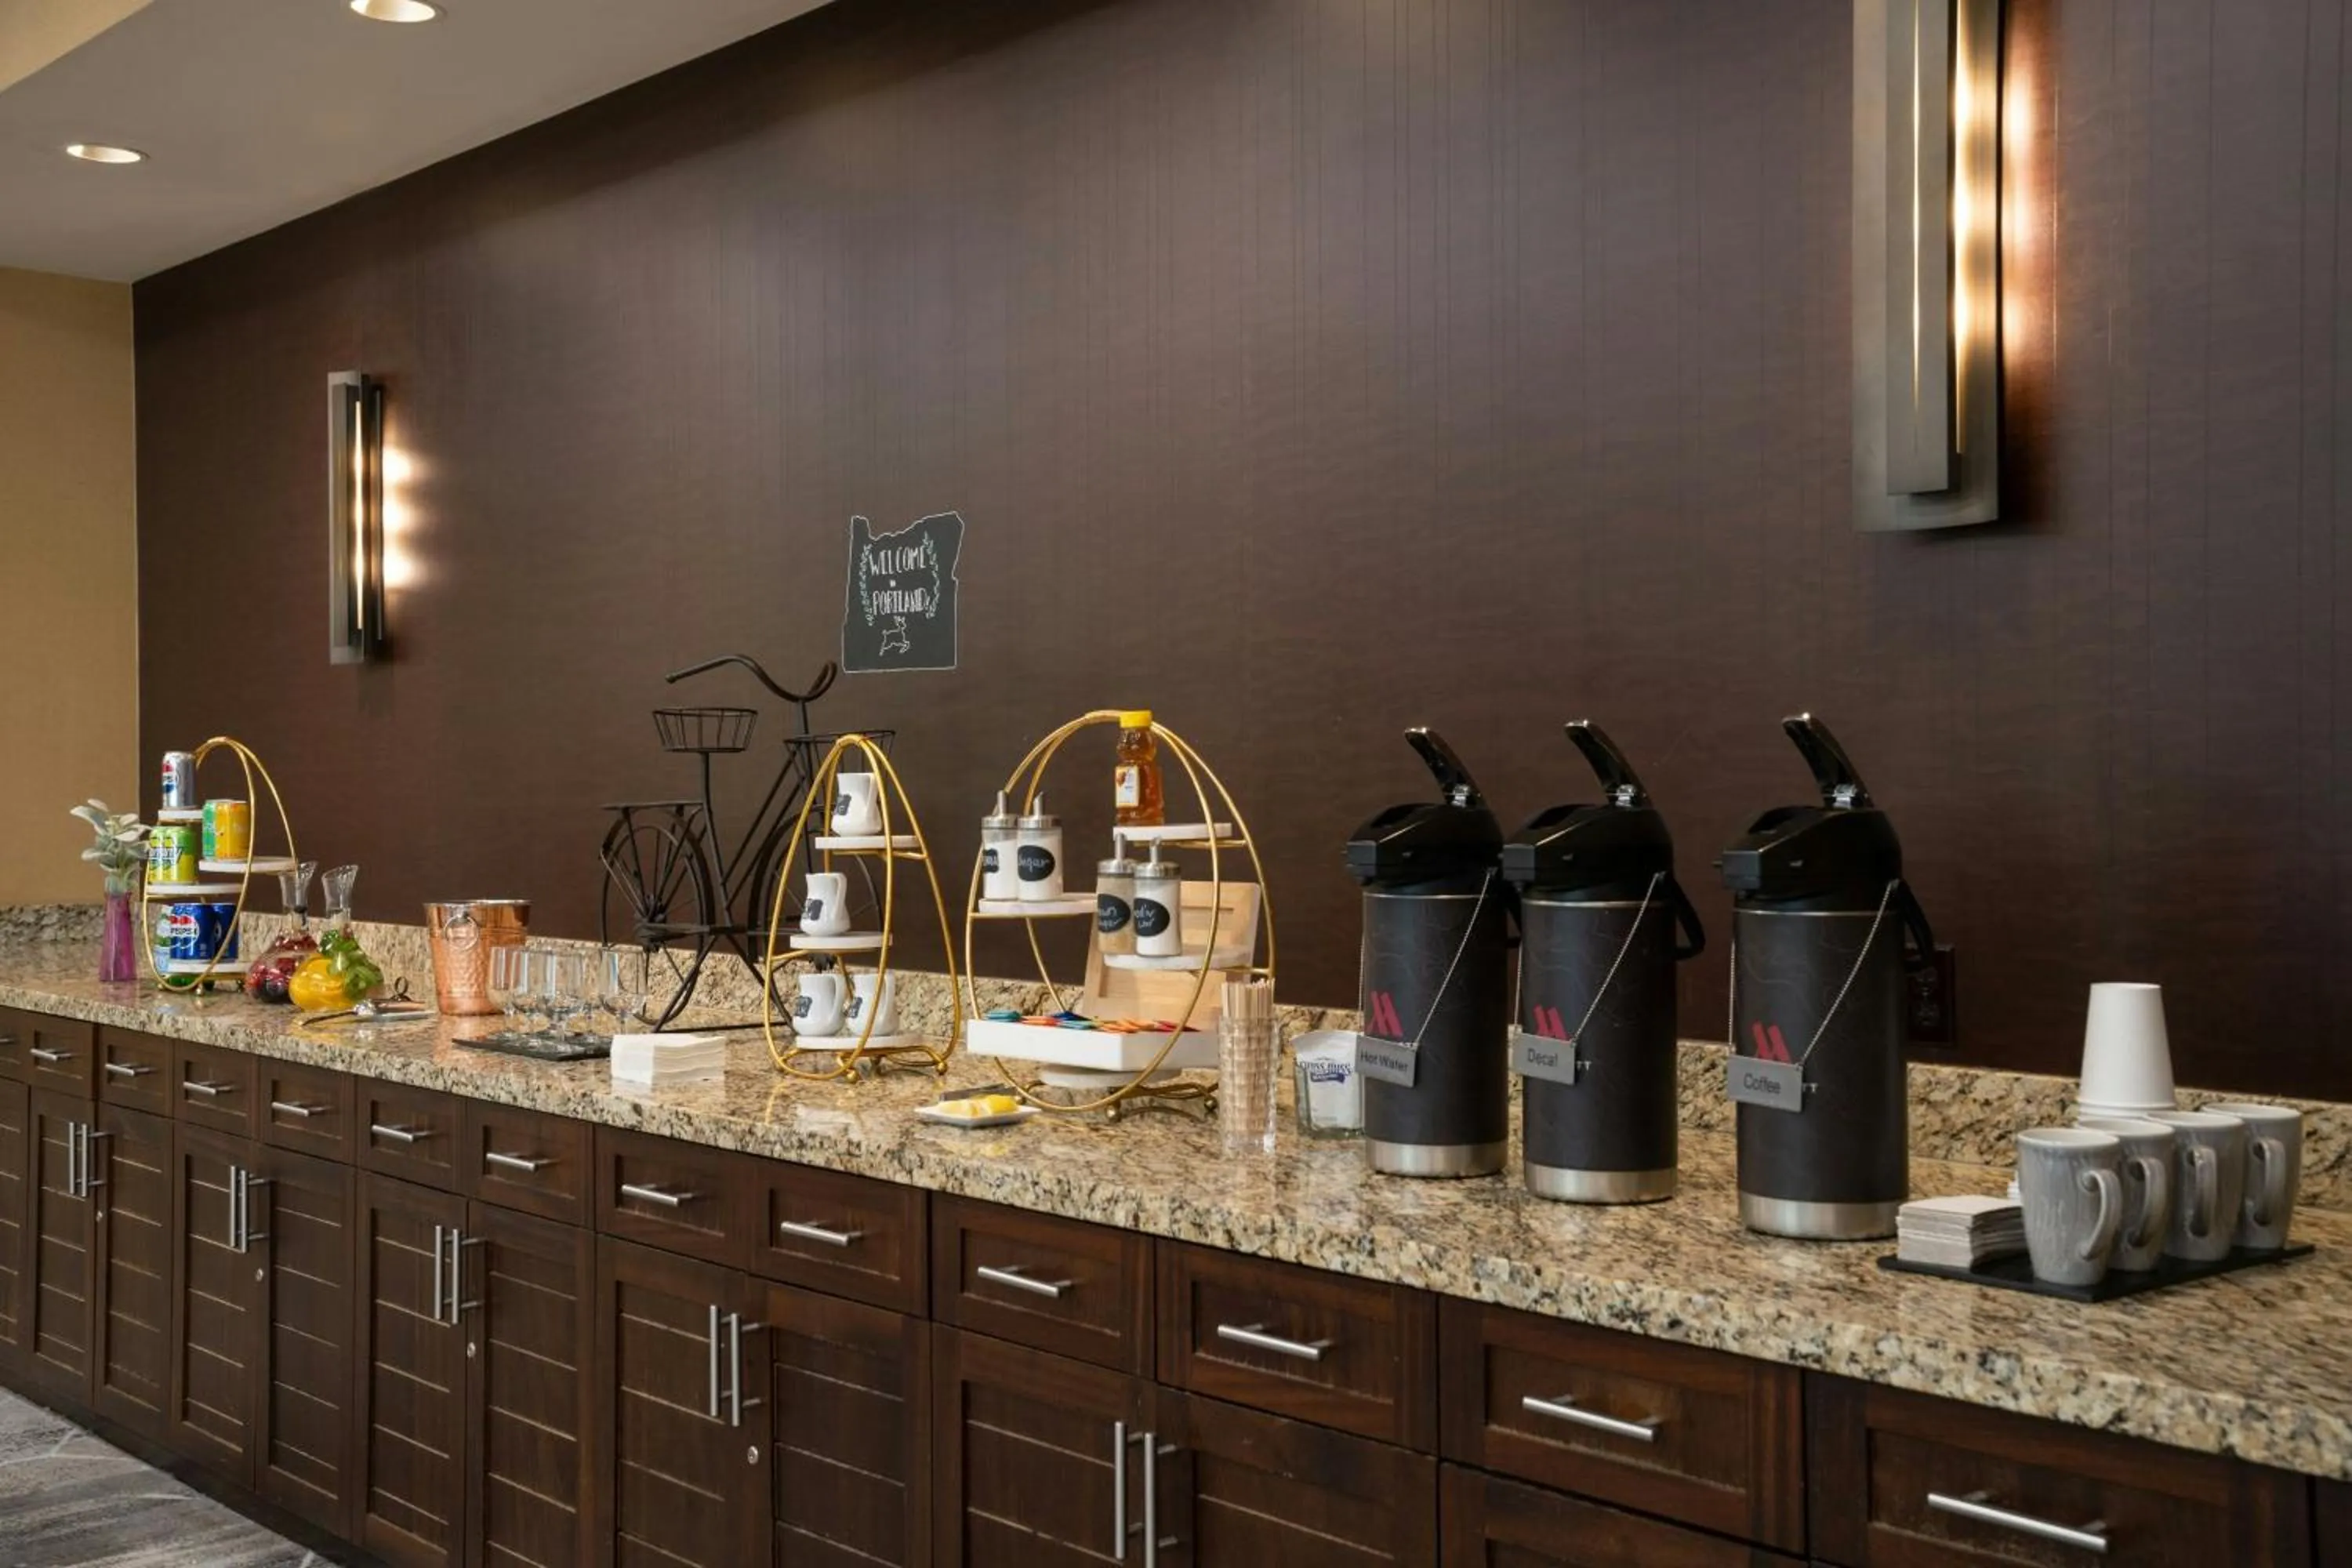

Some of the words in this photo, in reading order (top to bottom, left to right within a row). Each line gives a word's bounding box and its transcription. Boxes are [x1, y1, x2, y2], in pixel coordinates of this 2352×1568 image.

[869, 546, 926, 575] WELCOME
[1360, 1049, 1377, 1065] Hot
[1379, 1054, 1408, 1073] Water
[1744, 1073, 1781, 1094] Coffee
